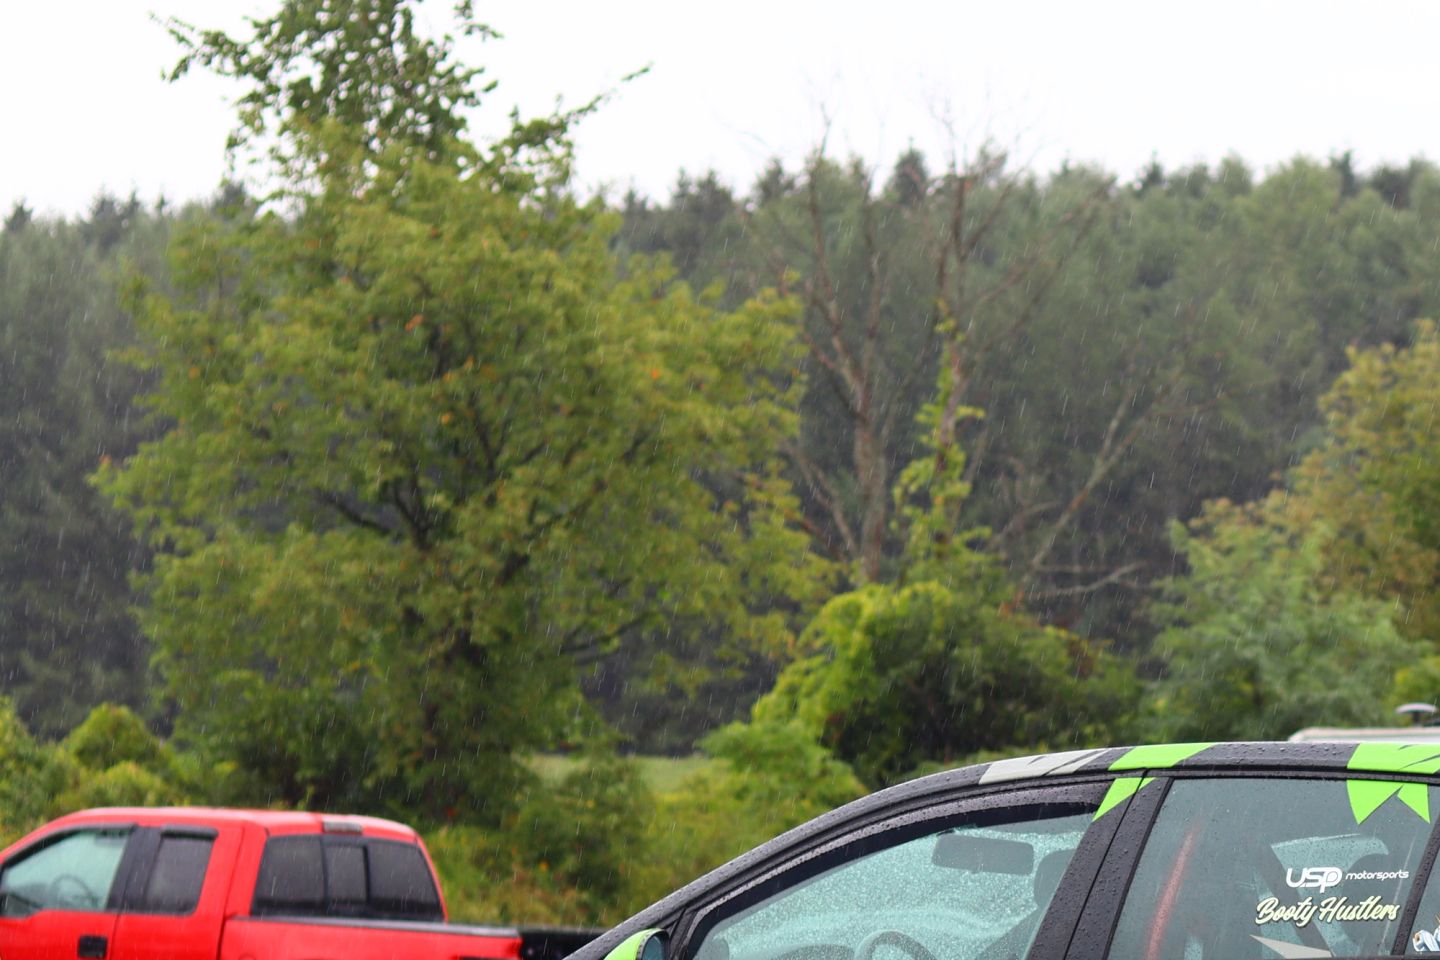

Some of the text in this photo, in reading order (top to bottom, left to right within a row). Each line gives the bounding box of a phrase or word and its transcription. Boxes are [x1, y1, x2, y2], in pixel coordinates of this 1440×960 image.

[1345, 870, 1410, 882] motorsports
[1255, 896, 1400, 927] Booty Hustlers
